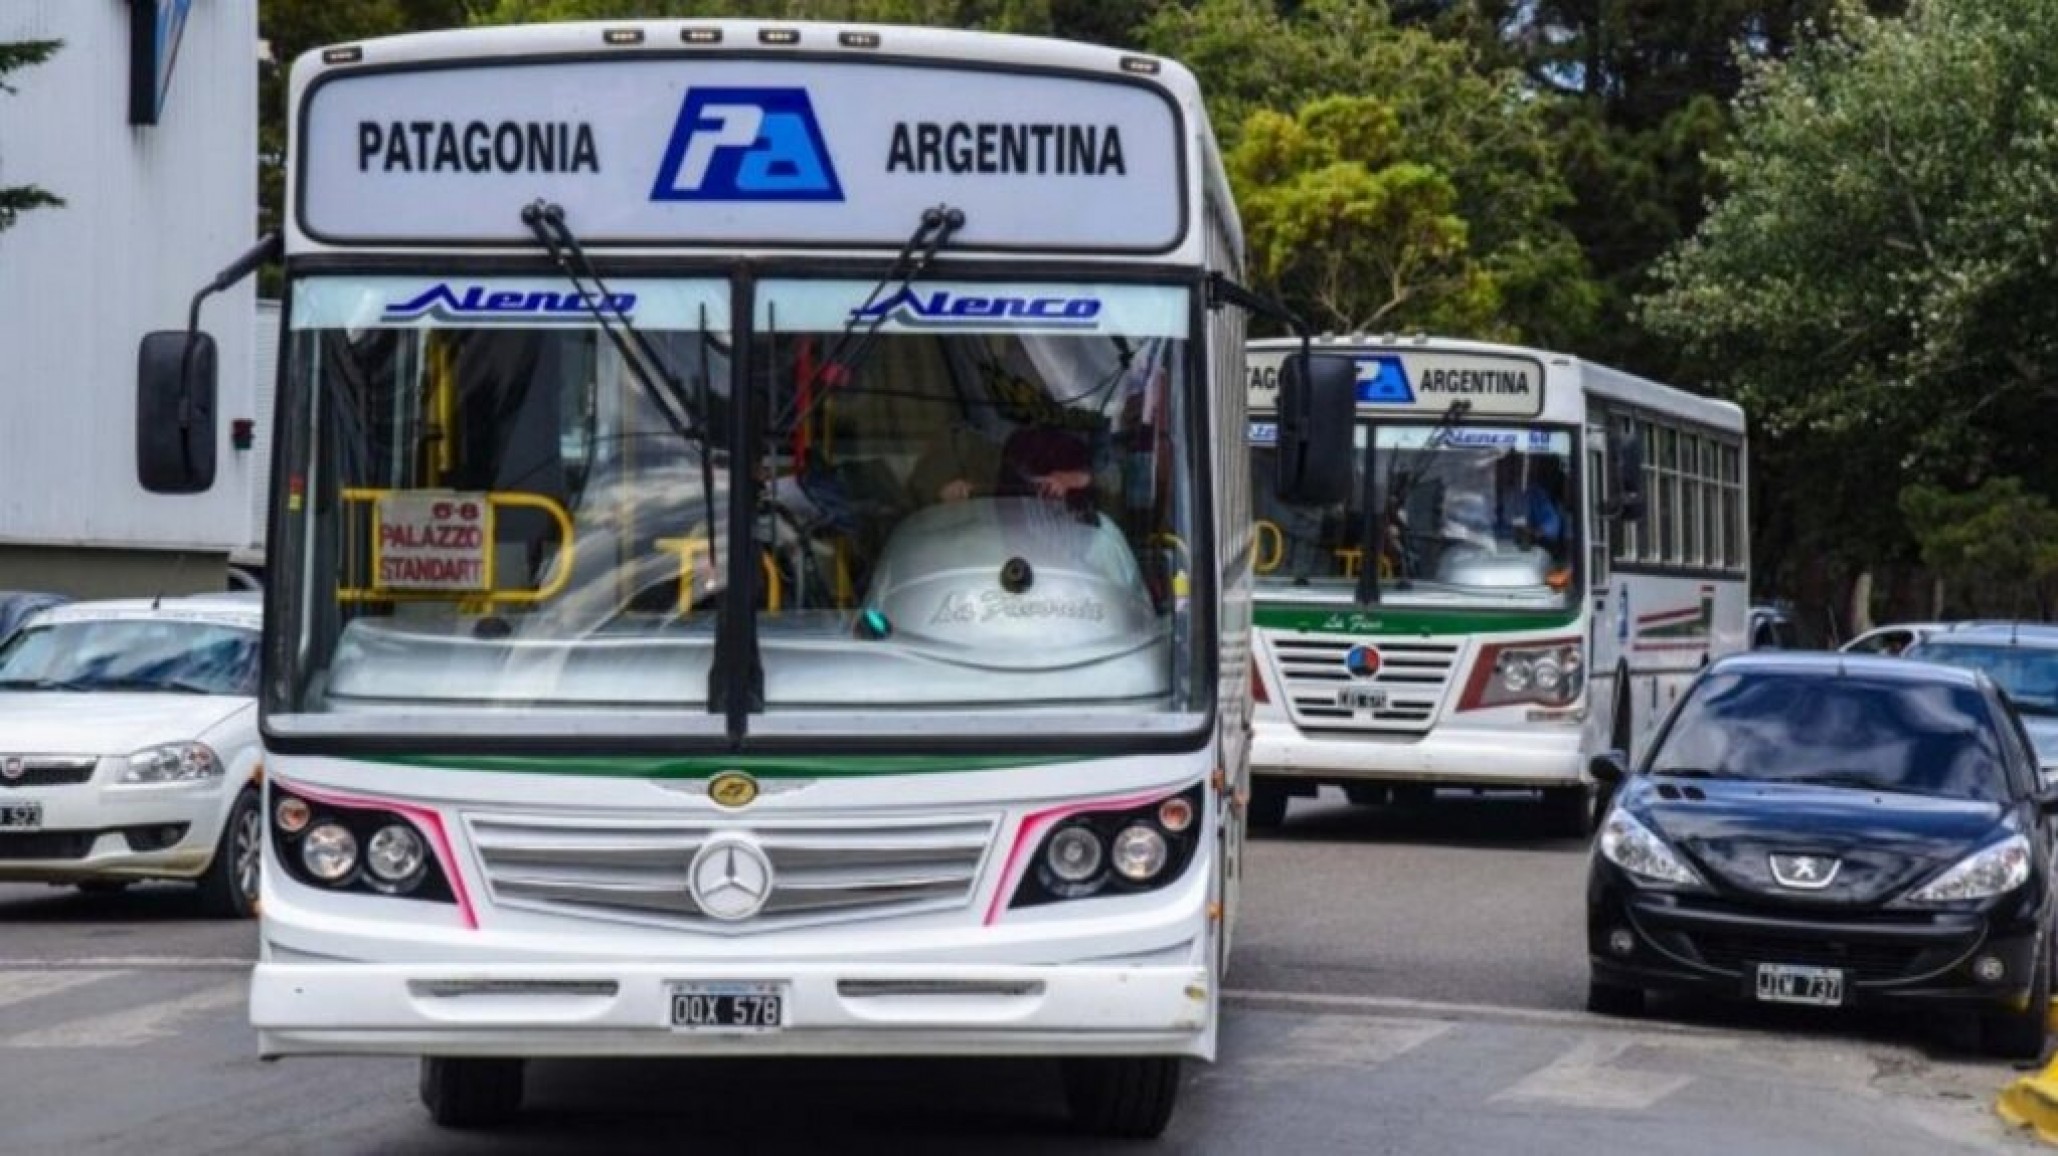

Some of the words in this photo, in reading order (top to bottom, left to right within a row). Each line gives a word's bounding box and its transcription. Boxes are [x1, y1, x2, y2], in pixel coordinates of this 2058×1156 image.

[358, 120, 600, 174] PATAGONIA
[885, 121, 1127, 176] ARGENTINA
[385, 284, 637, 312] Alenco
[850, 287, 1102, 318] Alenco
[1420, 369, 1529, 394] ARGENTINA
[379, 524, 483, 549] PALAZZO
[379, 555, 483, 581] STANDART
[733, 995, 778, 1025] 578
